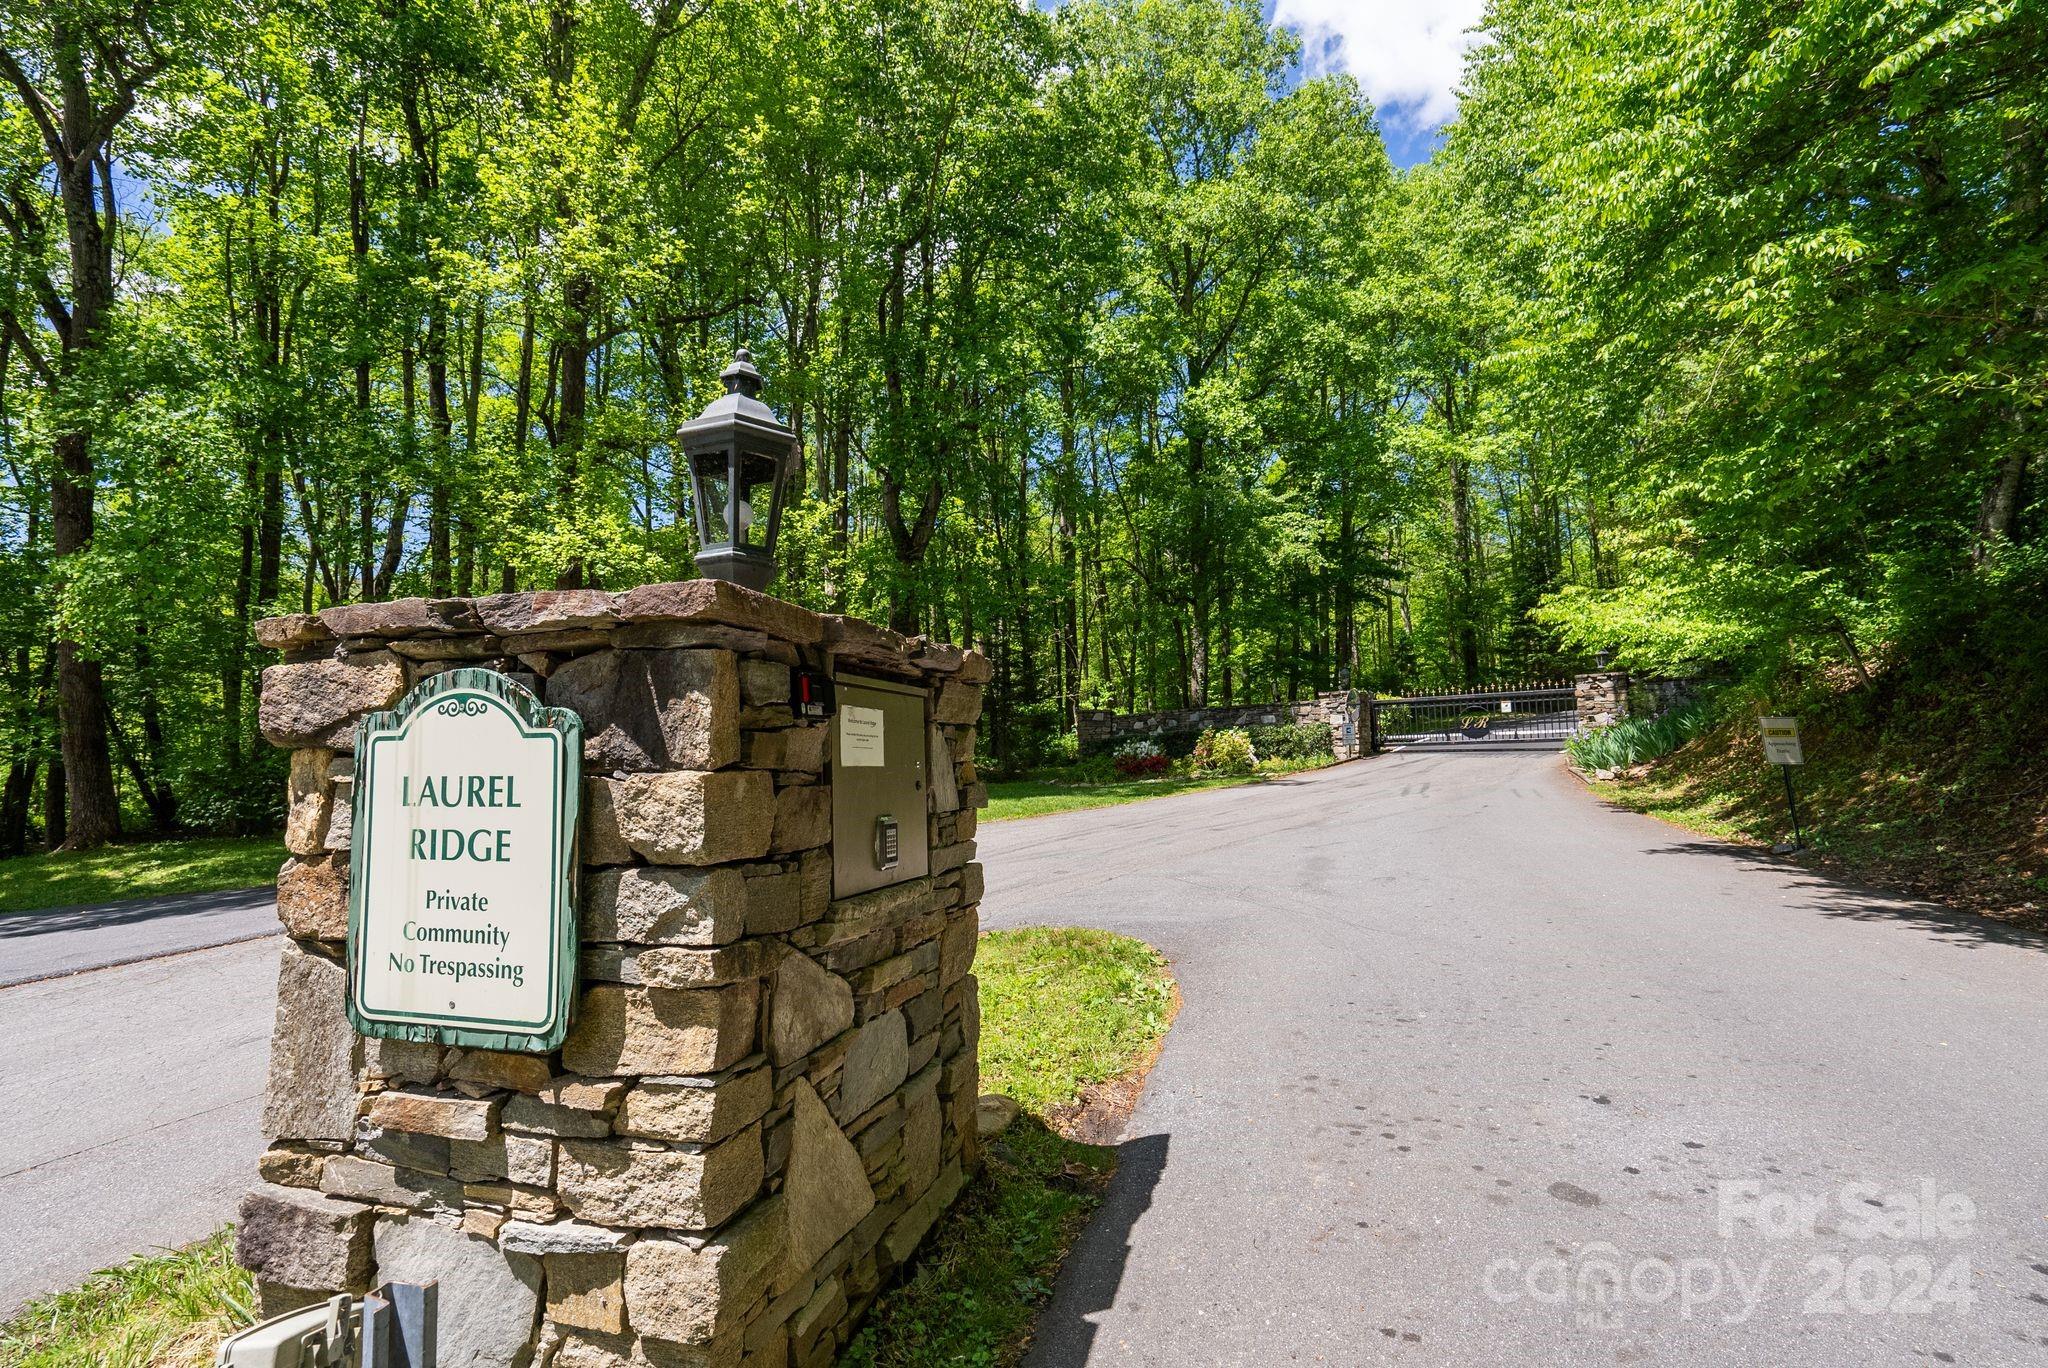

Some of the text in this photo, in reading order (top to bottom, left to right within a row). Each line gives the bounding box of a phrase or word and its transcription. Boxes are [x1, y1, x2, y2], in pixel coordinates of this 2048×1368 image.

[402, 775, 522, 808] LAUREL
[410, 828, 512, 863] RIDGE
[425, 889, 489, 913] Private
[402, 921, 511, 952] Community
[388, 953, 525, 988] No Trespassing
